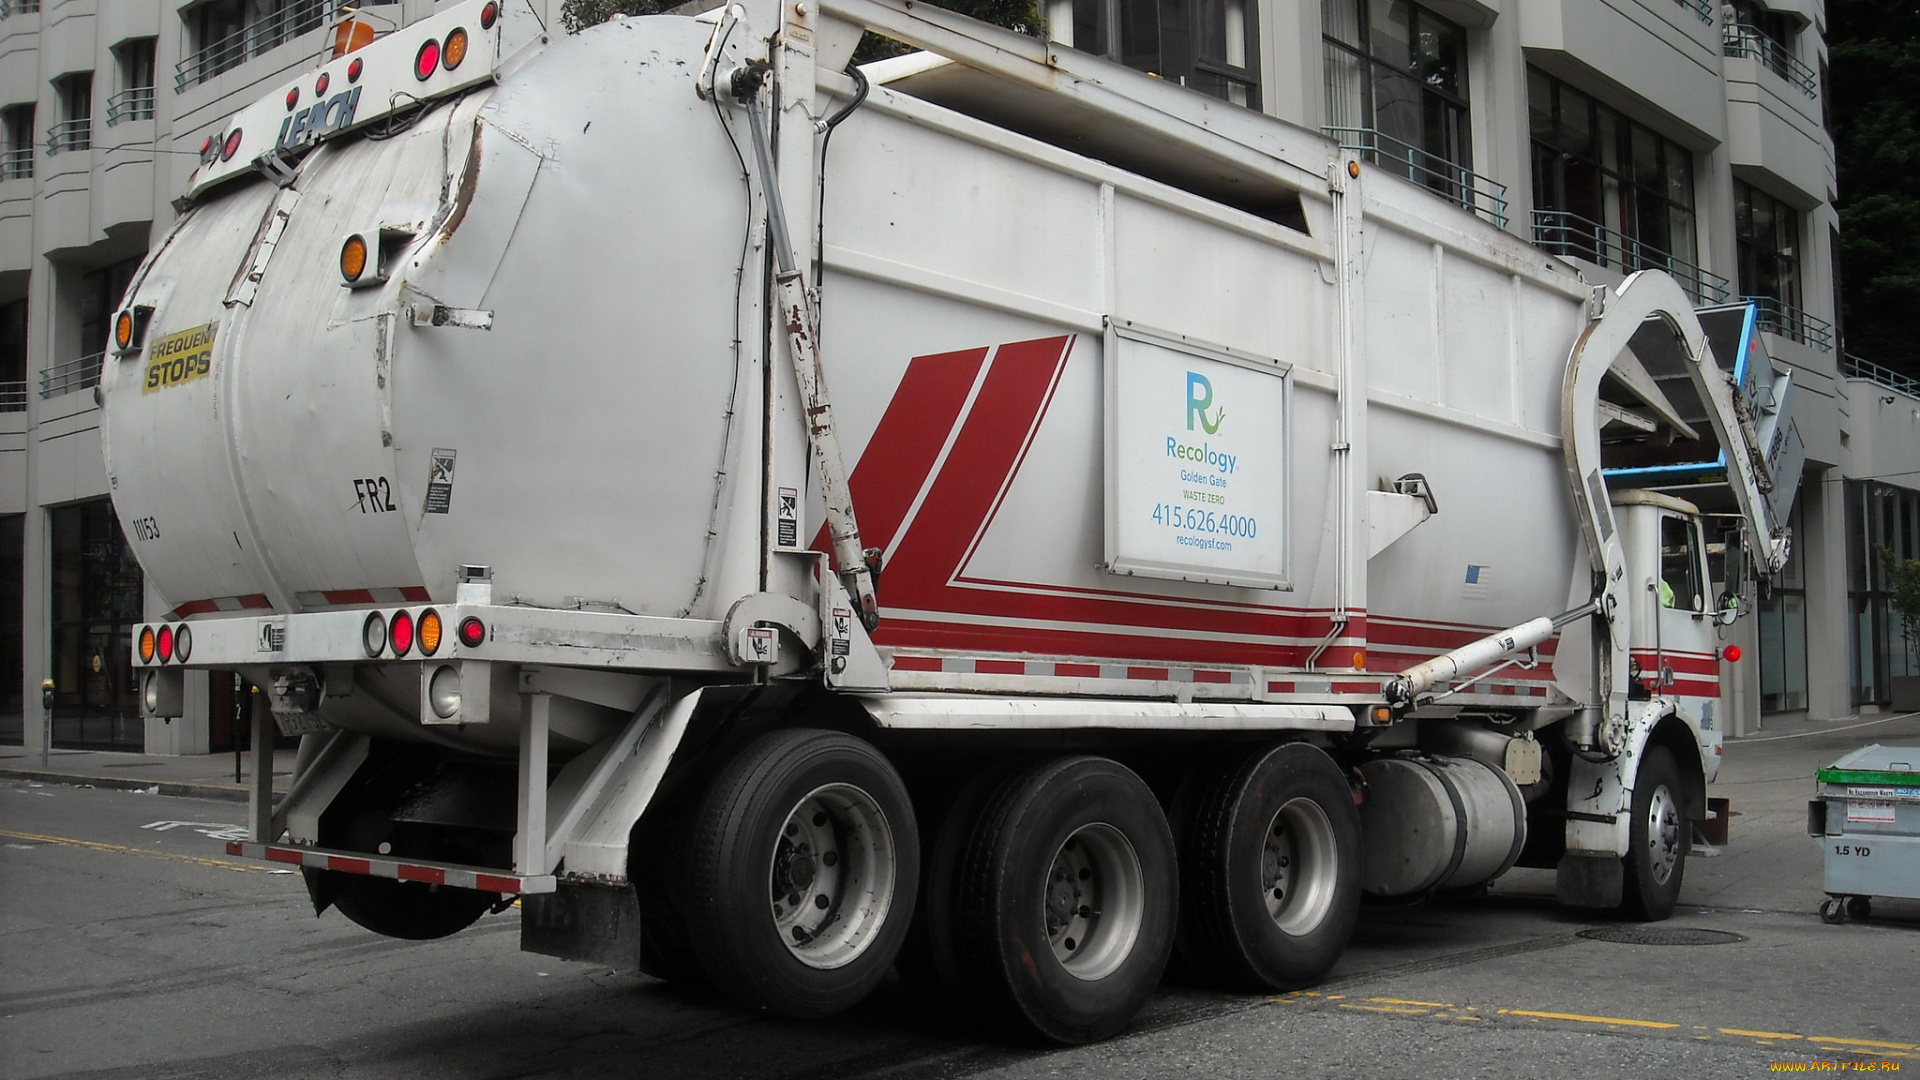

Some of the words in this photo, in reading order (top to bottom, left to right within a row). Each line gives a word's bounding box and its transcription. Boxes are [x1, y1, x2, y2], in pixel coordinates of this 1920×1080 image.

[275, 85, 362, 149] LEACH
[147, 350, 211, 388] STOPS
[1166, 436, 1237, 474] Recology
[1180, 469, 1208, 485] Golden
[1209, 474, 1227, 488] Gate
[353, 476, 397, 514] FR2
[1183, 489, 1206, 502] WASTE
[1207, 494, 1225, 505] ZERO
[133, 516, 160, 541] 11153
[1152, 503, 1256, 538] 415.626.4000
[1176, 535, 1232, 551] recologysf.com
[1834, 846, 1850, 856] 1.5
[1854, 847, 1870, 857] YD
